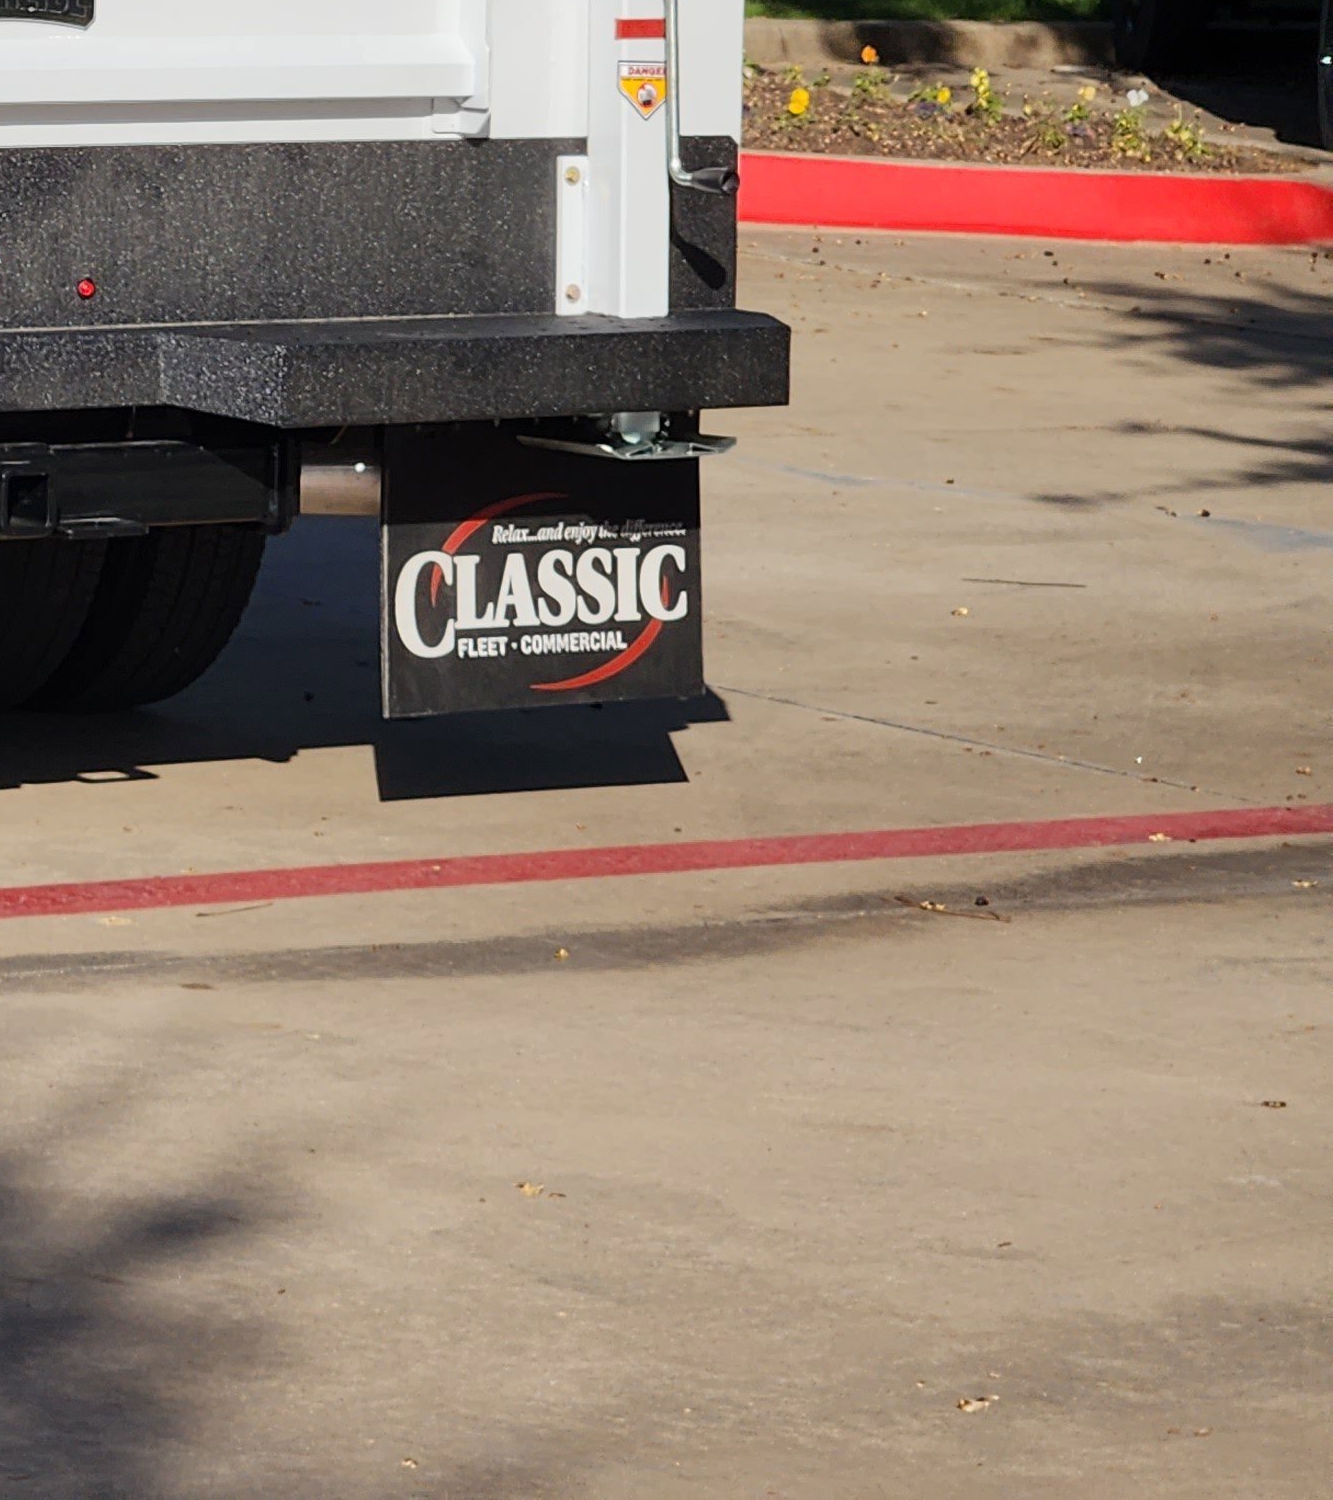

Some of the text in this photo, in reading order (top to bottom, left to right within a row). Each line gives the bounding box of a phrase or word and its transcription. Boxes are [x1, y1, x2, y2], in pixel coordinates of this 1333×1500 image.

[564, 521, 599, 545] enjoy
[598, 520, 619, 539] the
[395, 545, 687, 658] CLASSIC
[457, 631, 628, 659] FLEET COMMERCIAL
